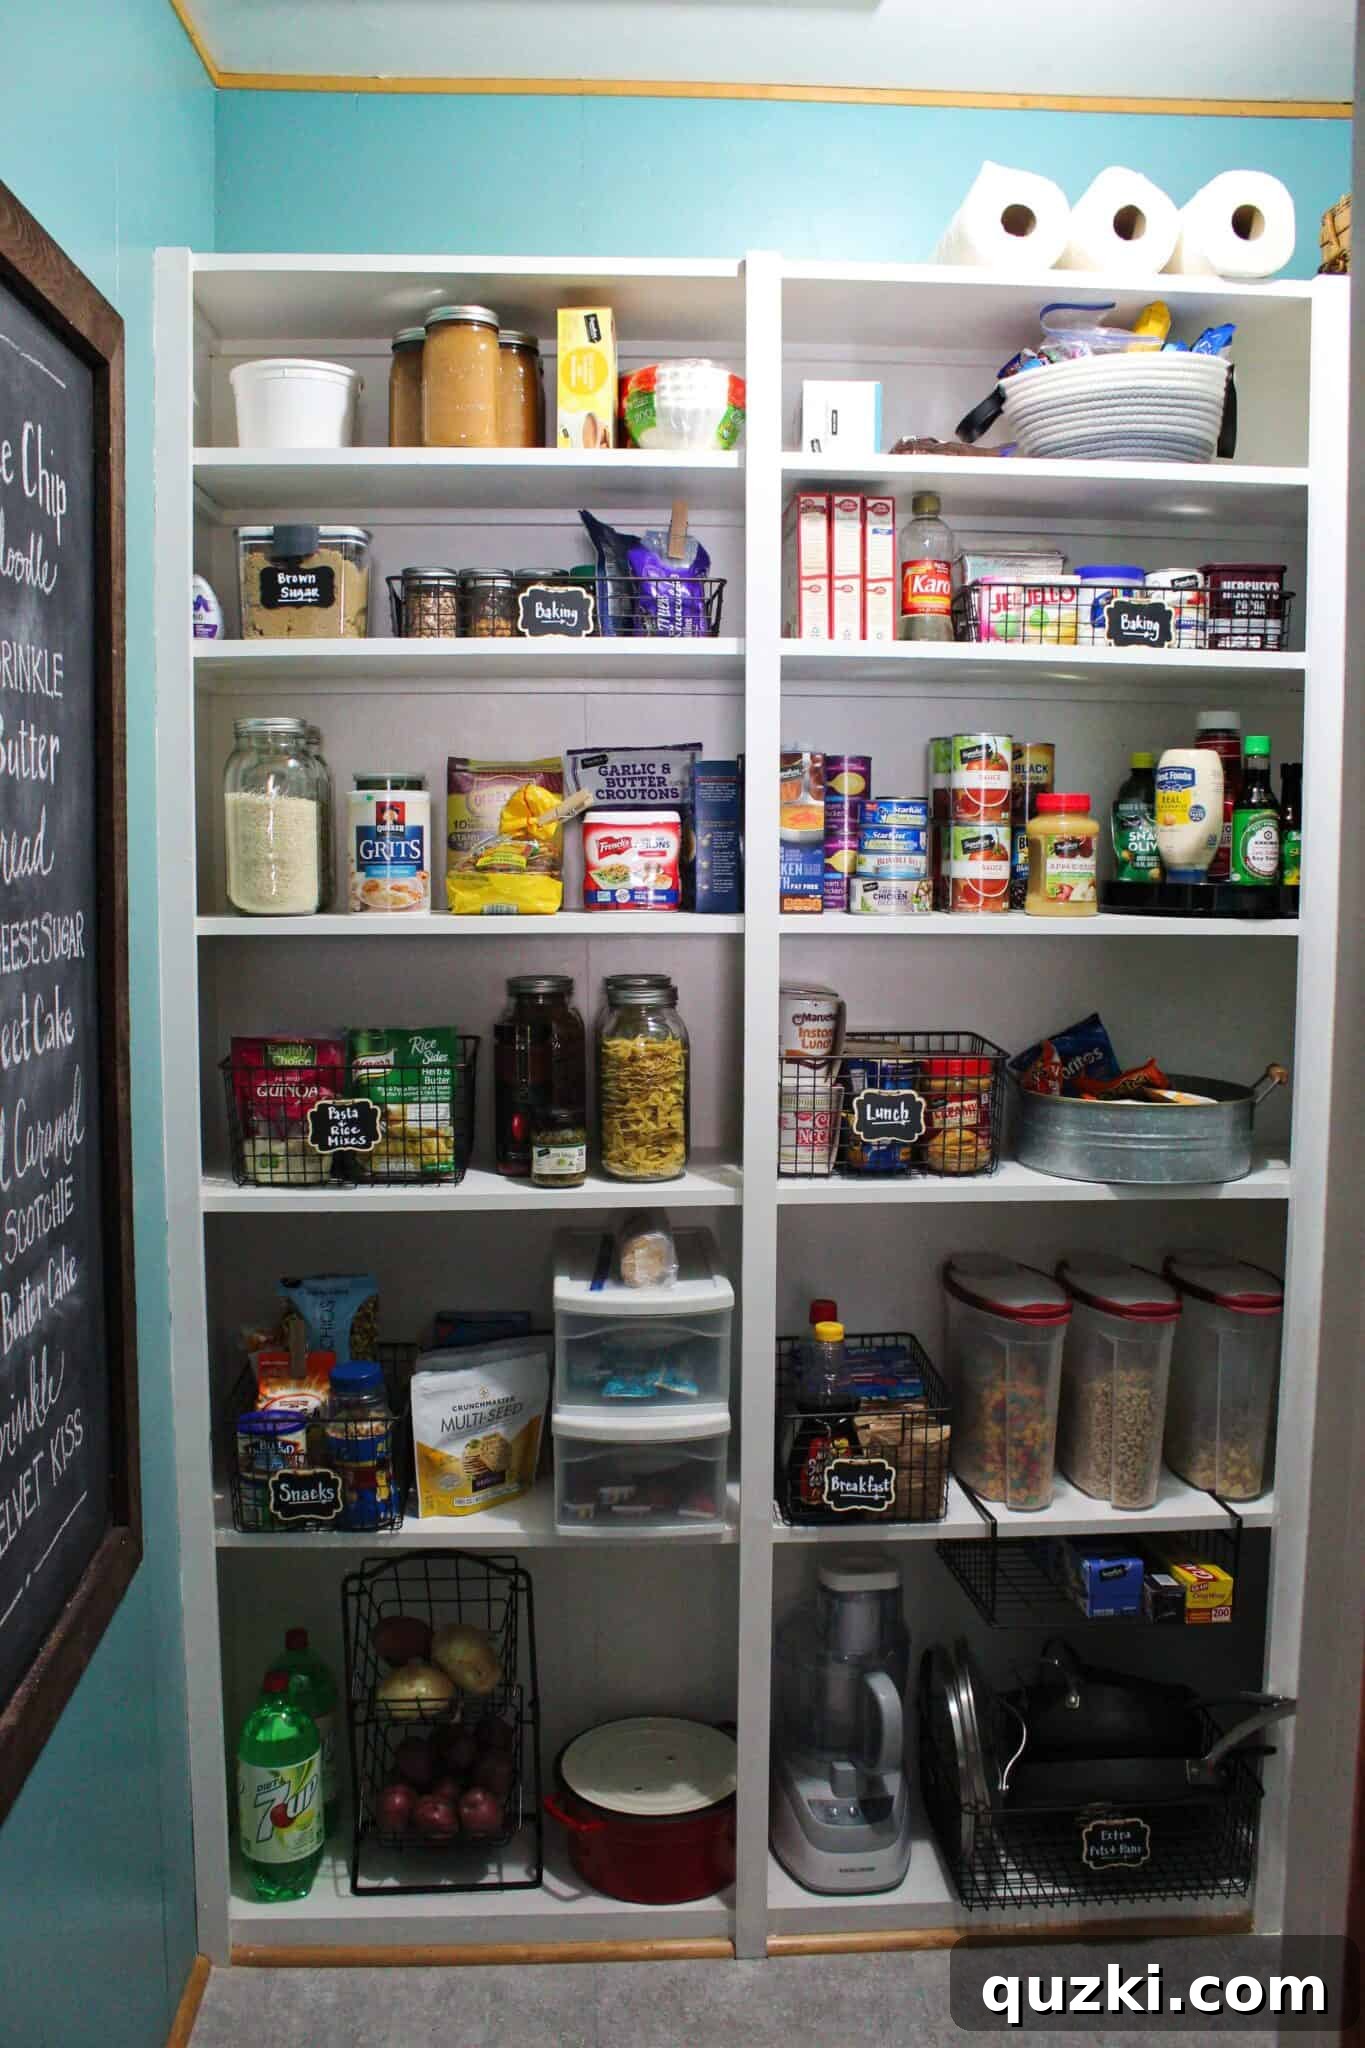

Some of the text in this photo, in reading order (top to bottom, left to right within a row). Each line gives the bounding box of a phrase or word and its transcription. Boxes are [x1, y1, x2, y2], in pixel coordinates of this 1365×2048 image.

[22, 421, 67, 547] Chip
[277, 572, 317, 584] Brown
[912, 574, 951, 594] Karo
[535, 600, 578, 627] Baking
[1120, 613, 1160, 642] Baking
[598, 763, 656, 776] GARLIC
[662, 763, 672, 774] &
[1015, 765, 1049, 774] BLACK
[605, 776, 667, 788] BUTTER
[595, 788, 680, 800] CROUTONS
[1128, 832, 1158, 841] SNA
[359, 840, 421, 861] GRITS
[1128, 842, 1159, 851] OLIV
[781, 863, 803, 876] KEN
[33, 984, 76, 1056] Cake
[409, 1036, 438, 1055] Rice
[422, 1051, 449, 1065] Sides
[1060, 1047, 1105, 1080] oritos
[256, 1083, 319, 1098] QUINOA
[327, 1106, 360, 1120] Pasta
[866, 1101, 910, 1121] Lunch
[14, 1064, 85, 1179] Caramel
[330, 1125, 360, 1136] Rice
[327, 1135, 367, 1147] Mixes
[4, 1174, 74, 1264] SCOTCHIE
[0, 1244, 78, 1354] Butter Cake
[50, 1408, 84, 1486] KISS
[279, 1481, 336, 1502] Snacks
[831, 1474, 890, 1494] Breakfast
[1213, 1609, 1229, 1617] 200
